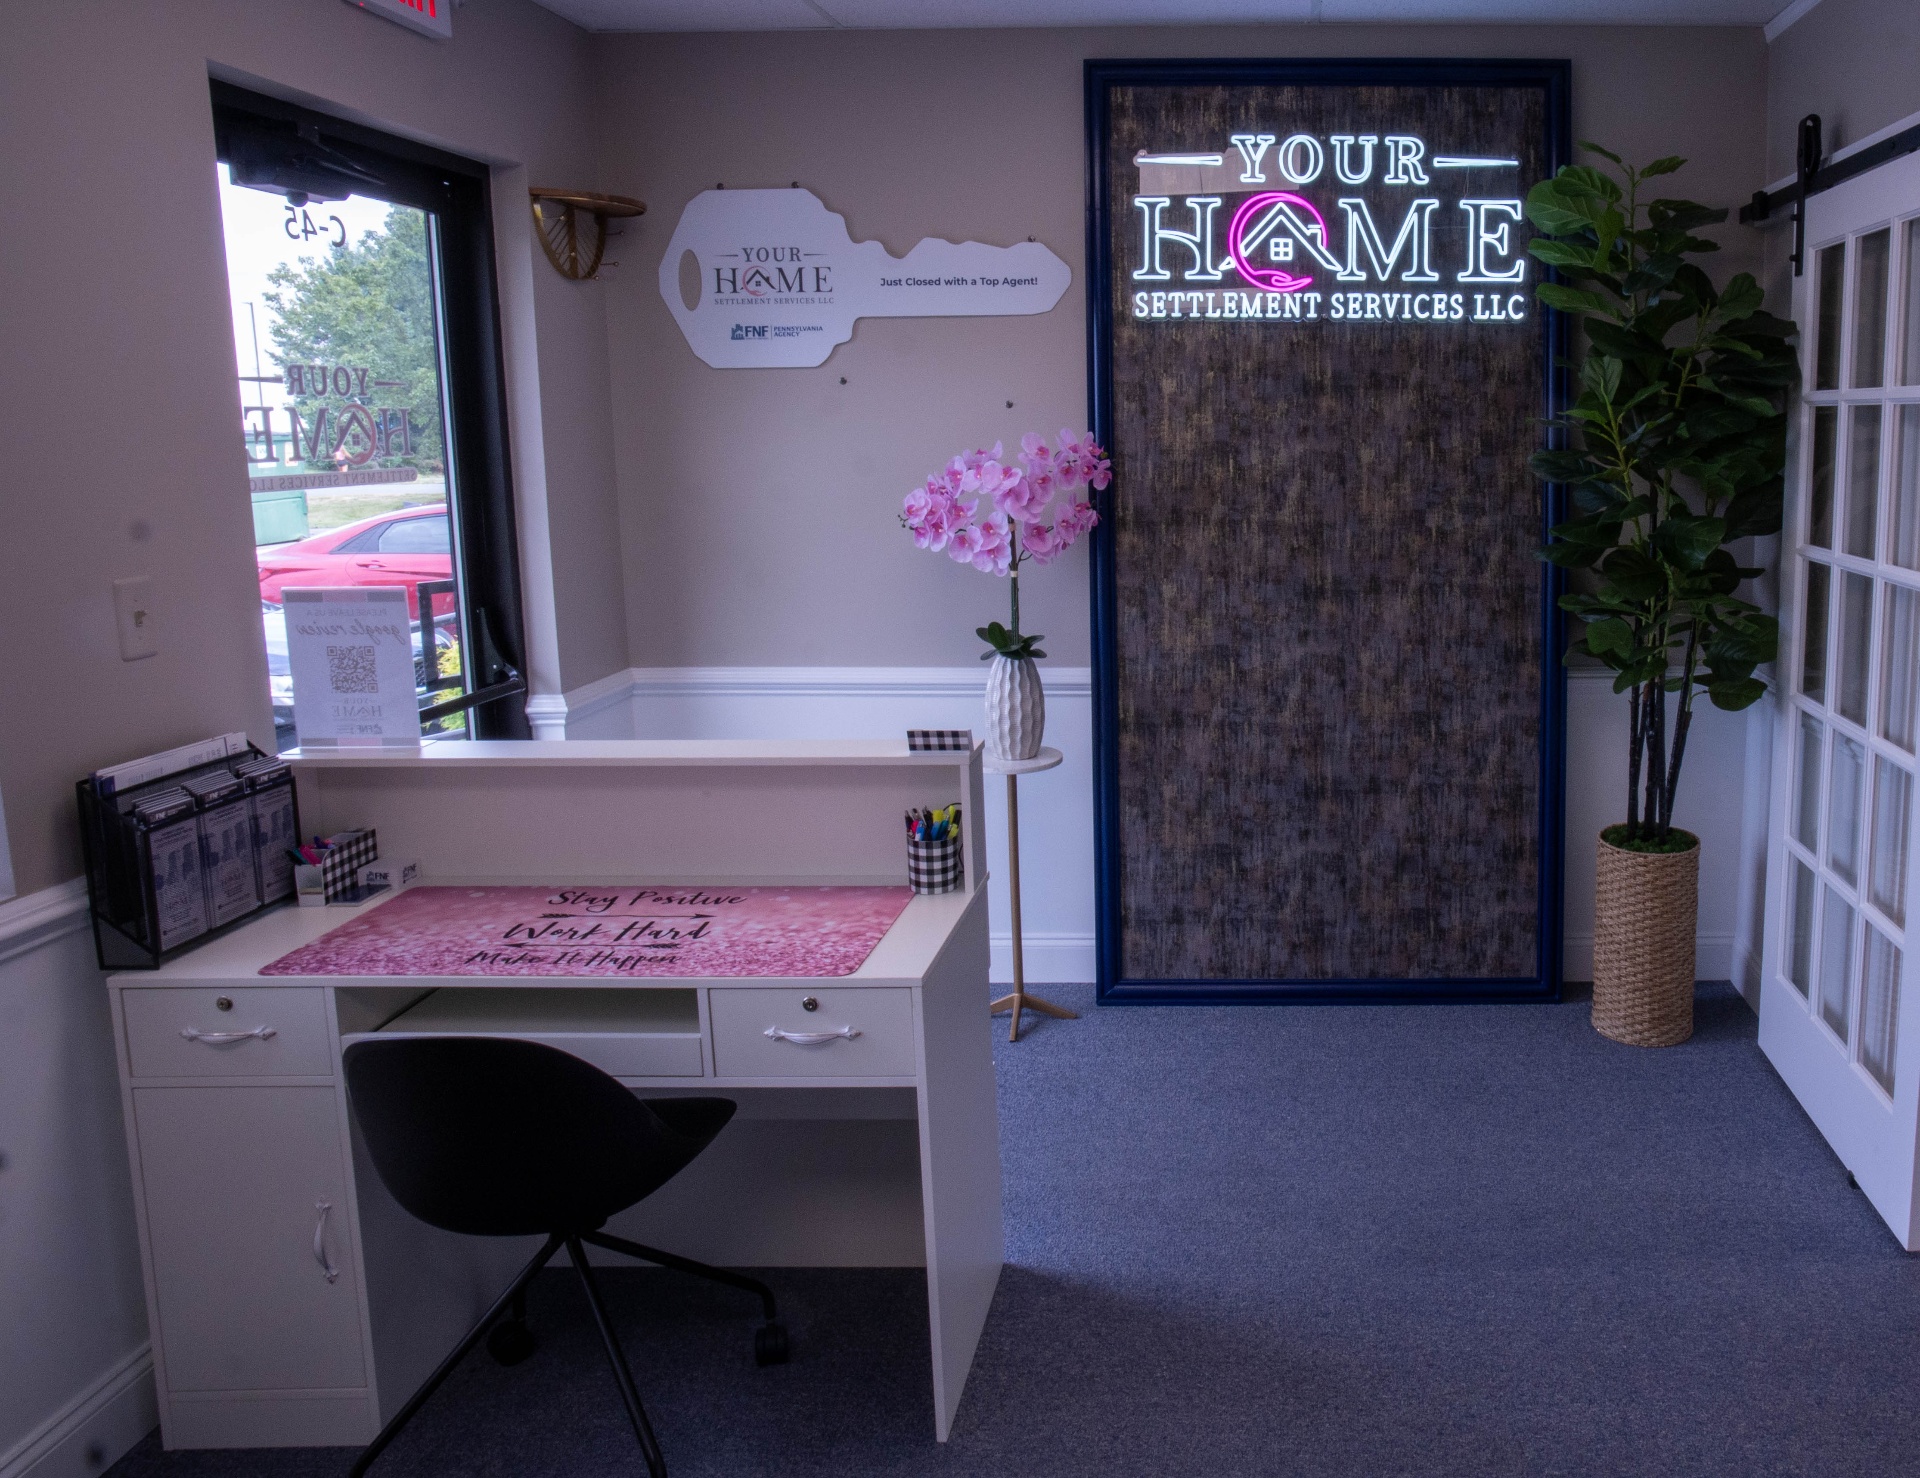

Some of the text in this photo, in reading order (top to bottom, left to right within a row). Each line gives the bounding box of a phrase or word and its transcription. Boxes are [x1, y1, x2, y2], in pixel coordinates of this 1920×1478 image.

[1230, 134, 1430, 185] YOUR
[1133, 193, 1525, 291] HOME
[742, 247, 802, 263] YOUR
[714, 265, 833, 296] HOME
[880, 276, 903, 287] Just
[905, 276, 942, 287] Closed
[943, 276, 968, 287] with
[979, 277, 1000, 288] Top
[1001, 276, 1038, 289] Agent!
[773, 297, 816, 305] SERVICES
[817, 297, 835, 305] LLC
[1134, 292, 1525, 320] SETTLEMENT SERVICES LLC
[744, 325, 769, 337] FNF
[374, 872, 390, 880] FNF
[548, 890, 747, 913] Stay Positive
[503, 920, 711, 941] Work Hard
[465, 950, 683, 971] Make It Happen
